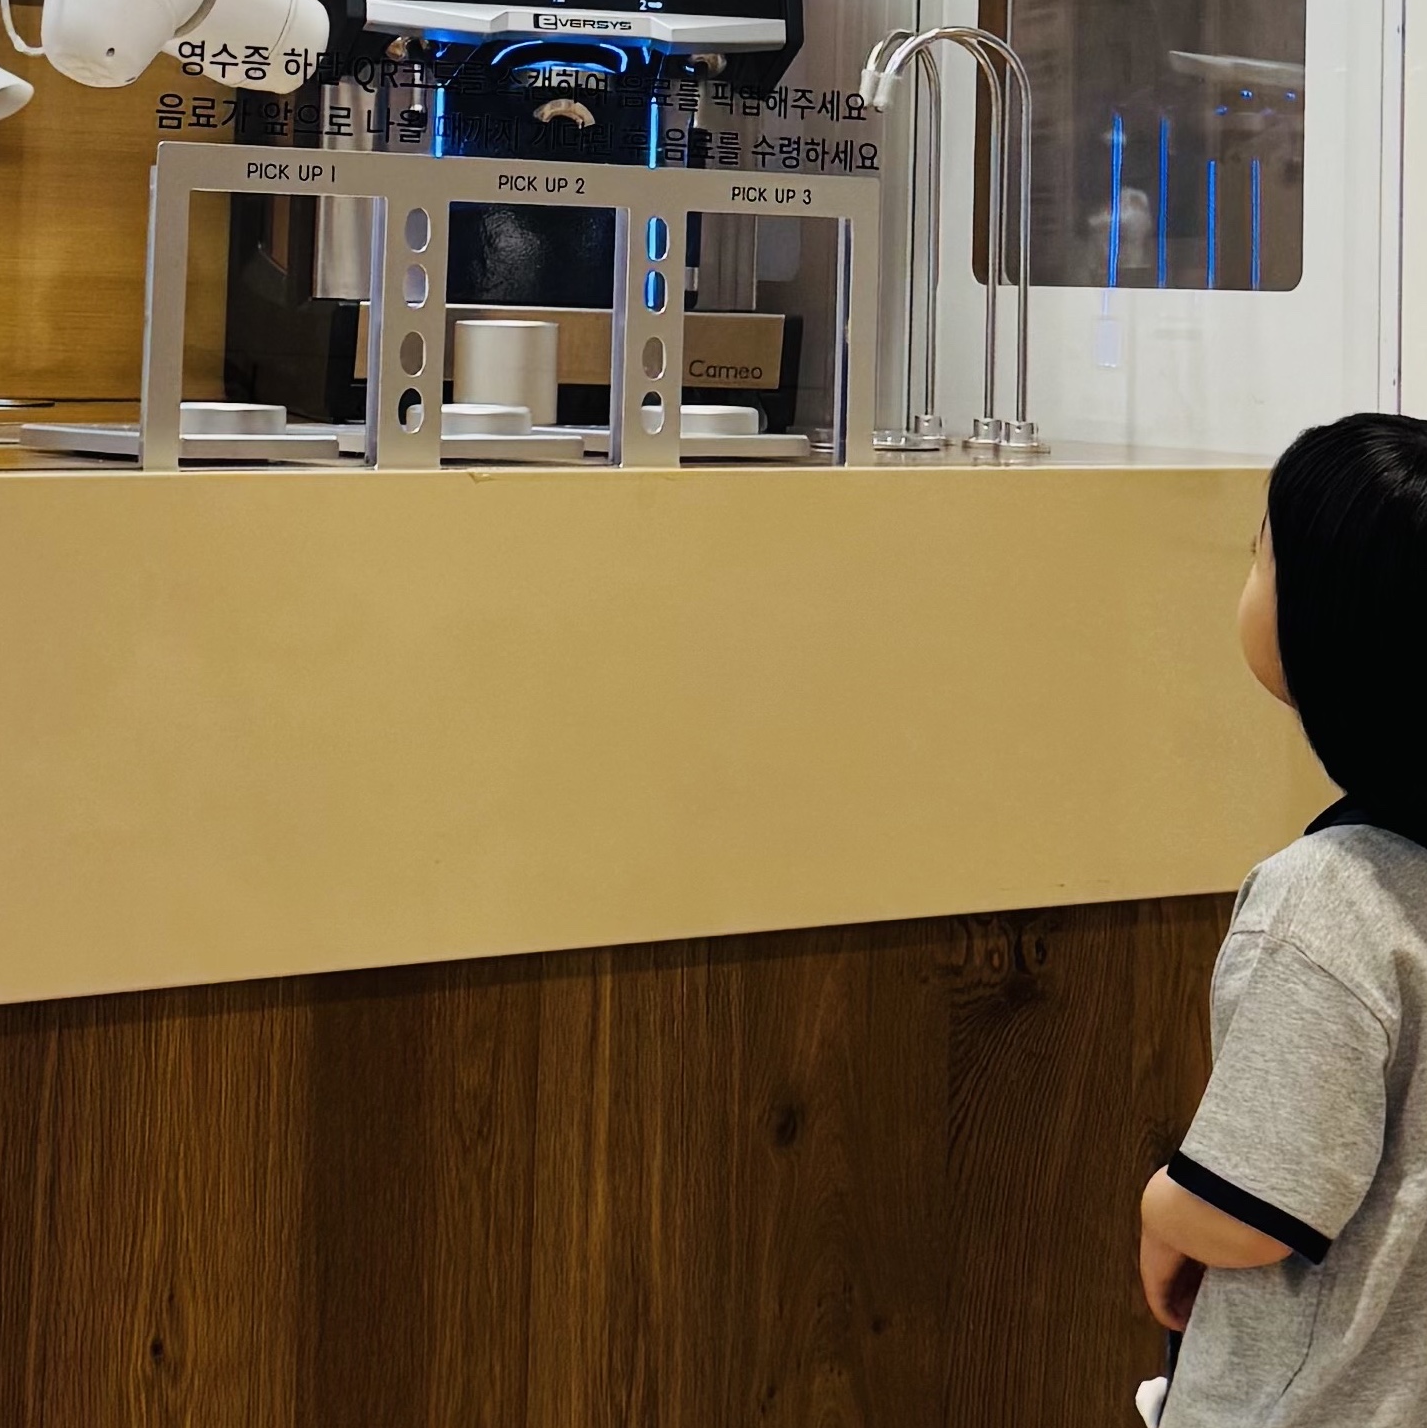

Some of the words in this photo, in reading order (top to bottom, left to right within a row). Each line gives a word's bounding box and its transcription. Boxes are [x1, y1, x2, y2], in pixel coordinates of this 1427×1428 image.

[178, 40, 271, 80] 영수증
[283, 46, 343, 86] 하단
[353, 55, 490, 95] QR코드를
[155, 93, 249, 133] 음료가
[263, 101, 353, 137] 앞으로
[664, 128, 742, 166] 음료를
[752, 135, 880, 172] 수령하세요
[247, 162, 290, 181] PICK
[298, 164, 323, 182] UP
[498, 174, 538, 192] PICK
[545, 177, 568, 193] UP
[575, 178, 585, 194] 2
[731, 186, 768, 203] PICK
[775, 188, 796, 204] UP
[803, 189, 812, 205] 3
[689, 359, 763, 380] Cameo
